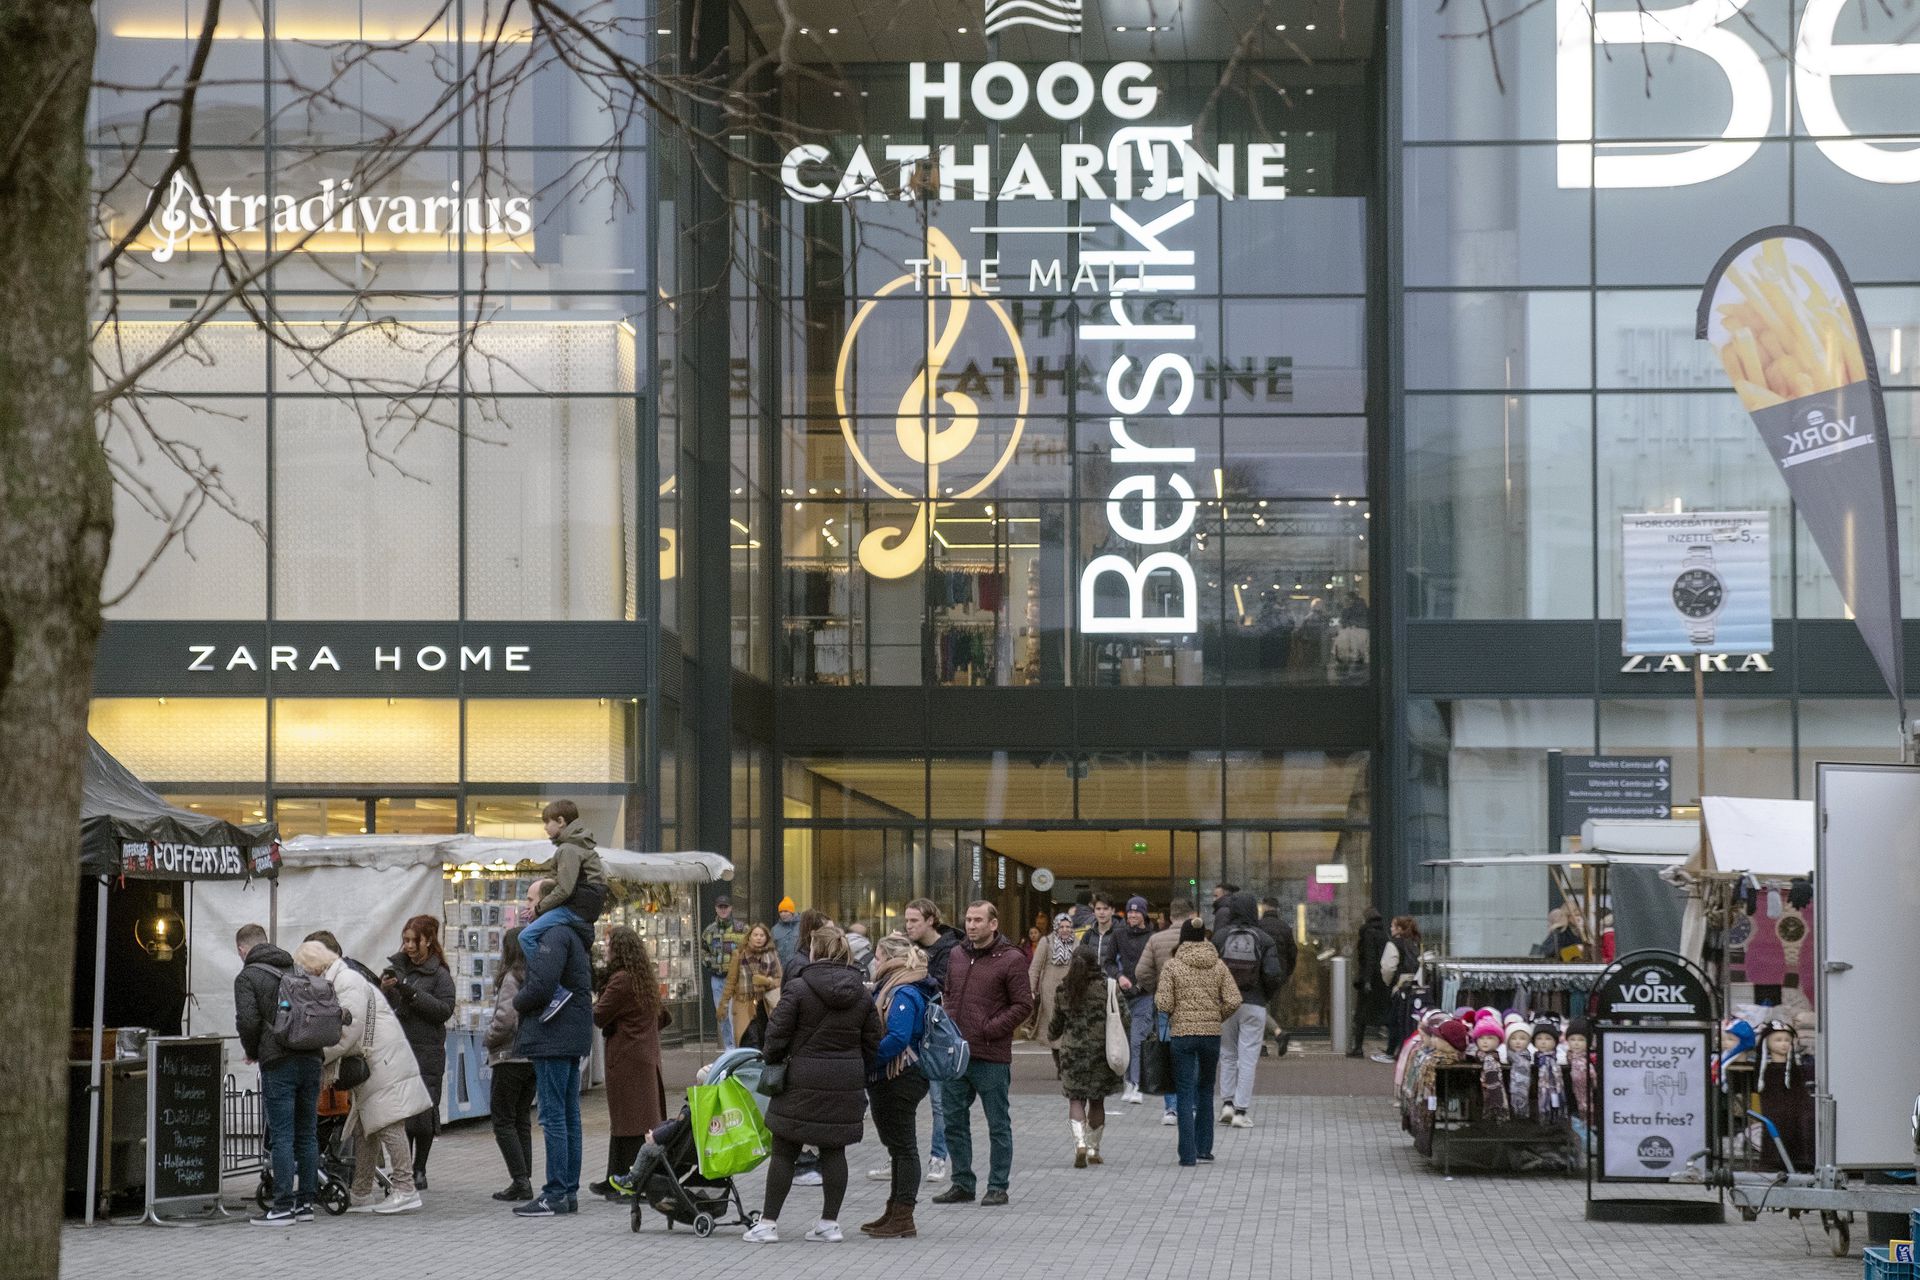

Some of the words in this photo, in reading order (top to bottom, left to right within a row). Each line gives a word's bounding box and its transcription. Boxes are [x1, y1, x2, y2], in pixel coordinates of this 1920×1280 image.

[909, 60, 1158, 121] HOOG
[780, 142, 1287, 202] CATHARIJNE
[904, 258, 1001, 292] THE
[1029, 258, 1158, 293] MALL
[1080, 124, 1198, 634] Bershka
[188, 645, 341, 671] ZARA
[375, 645, 531, 671] HOME
[1621, 653, 1774, 673] ZARA
[153, 843, 241, 874] POFFERTJES
[1619, 984, 1687, 1003] VORK
[1613, 1041, 1637, 1054] Did
[1639, 1045, 1667, 1058] you
[1671, 1046, 1696, 1059] say
[1612, 1056, 1680, 1069] exercise?
[1612, 1087, 1630, 1096] or
[1613, 1111, 1652, 1125] Extra
[1655, 1112, 1694, 1127] fries?
[1639, 1147, 1673, 1157] VORK
